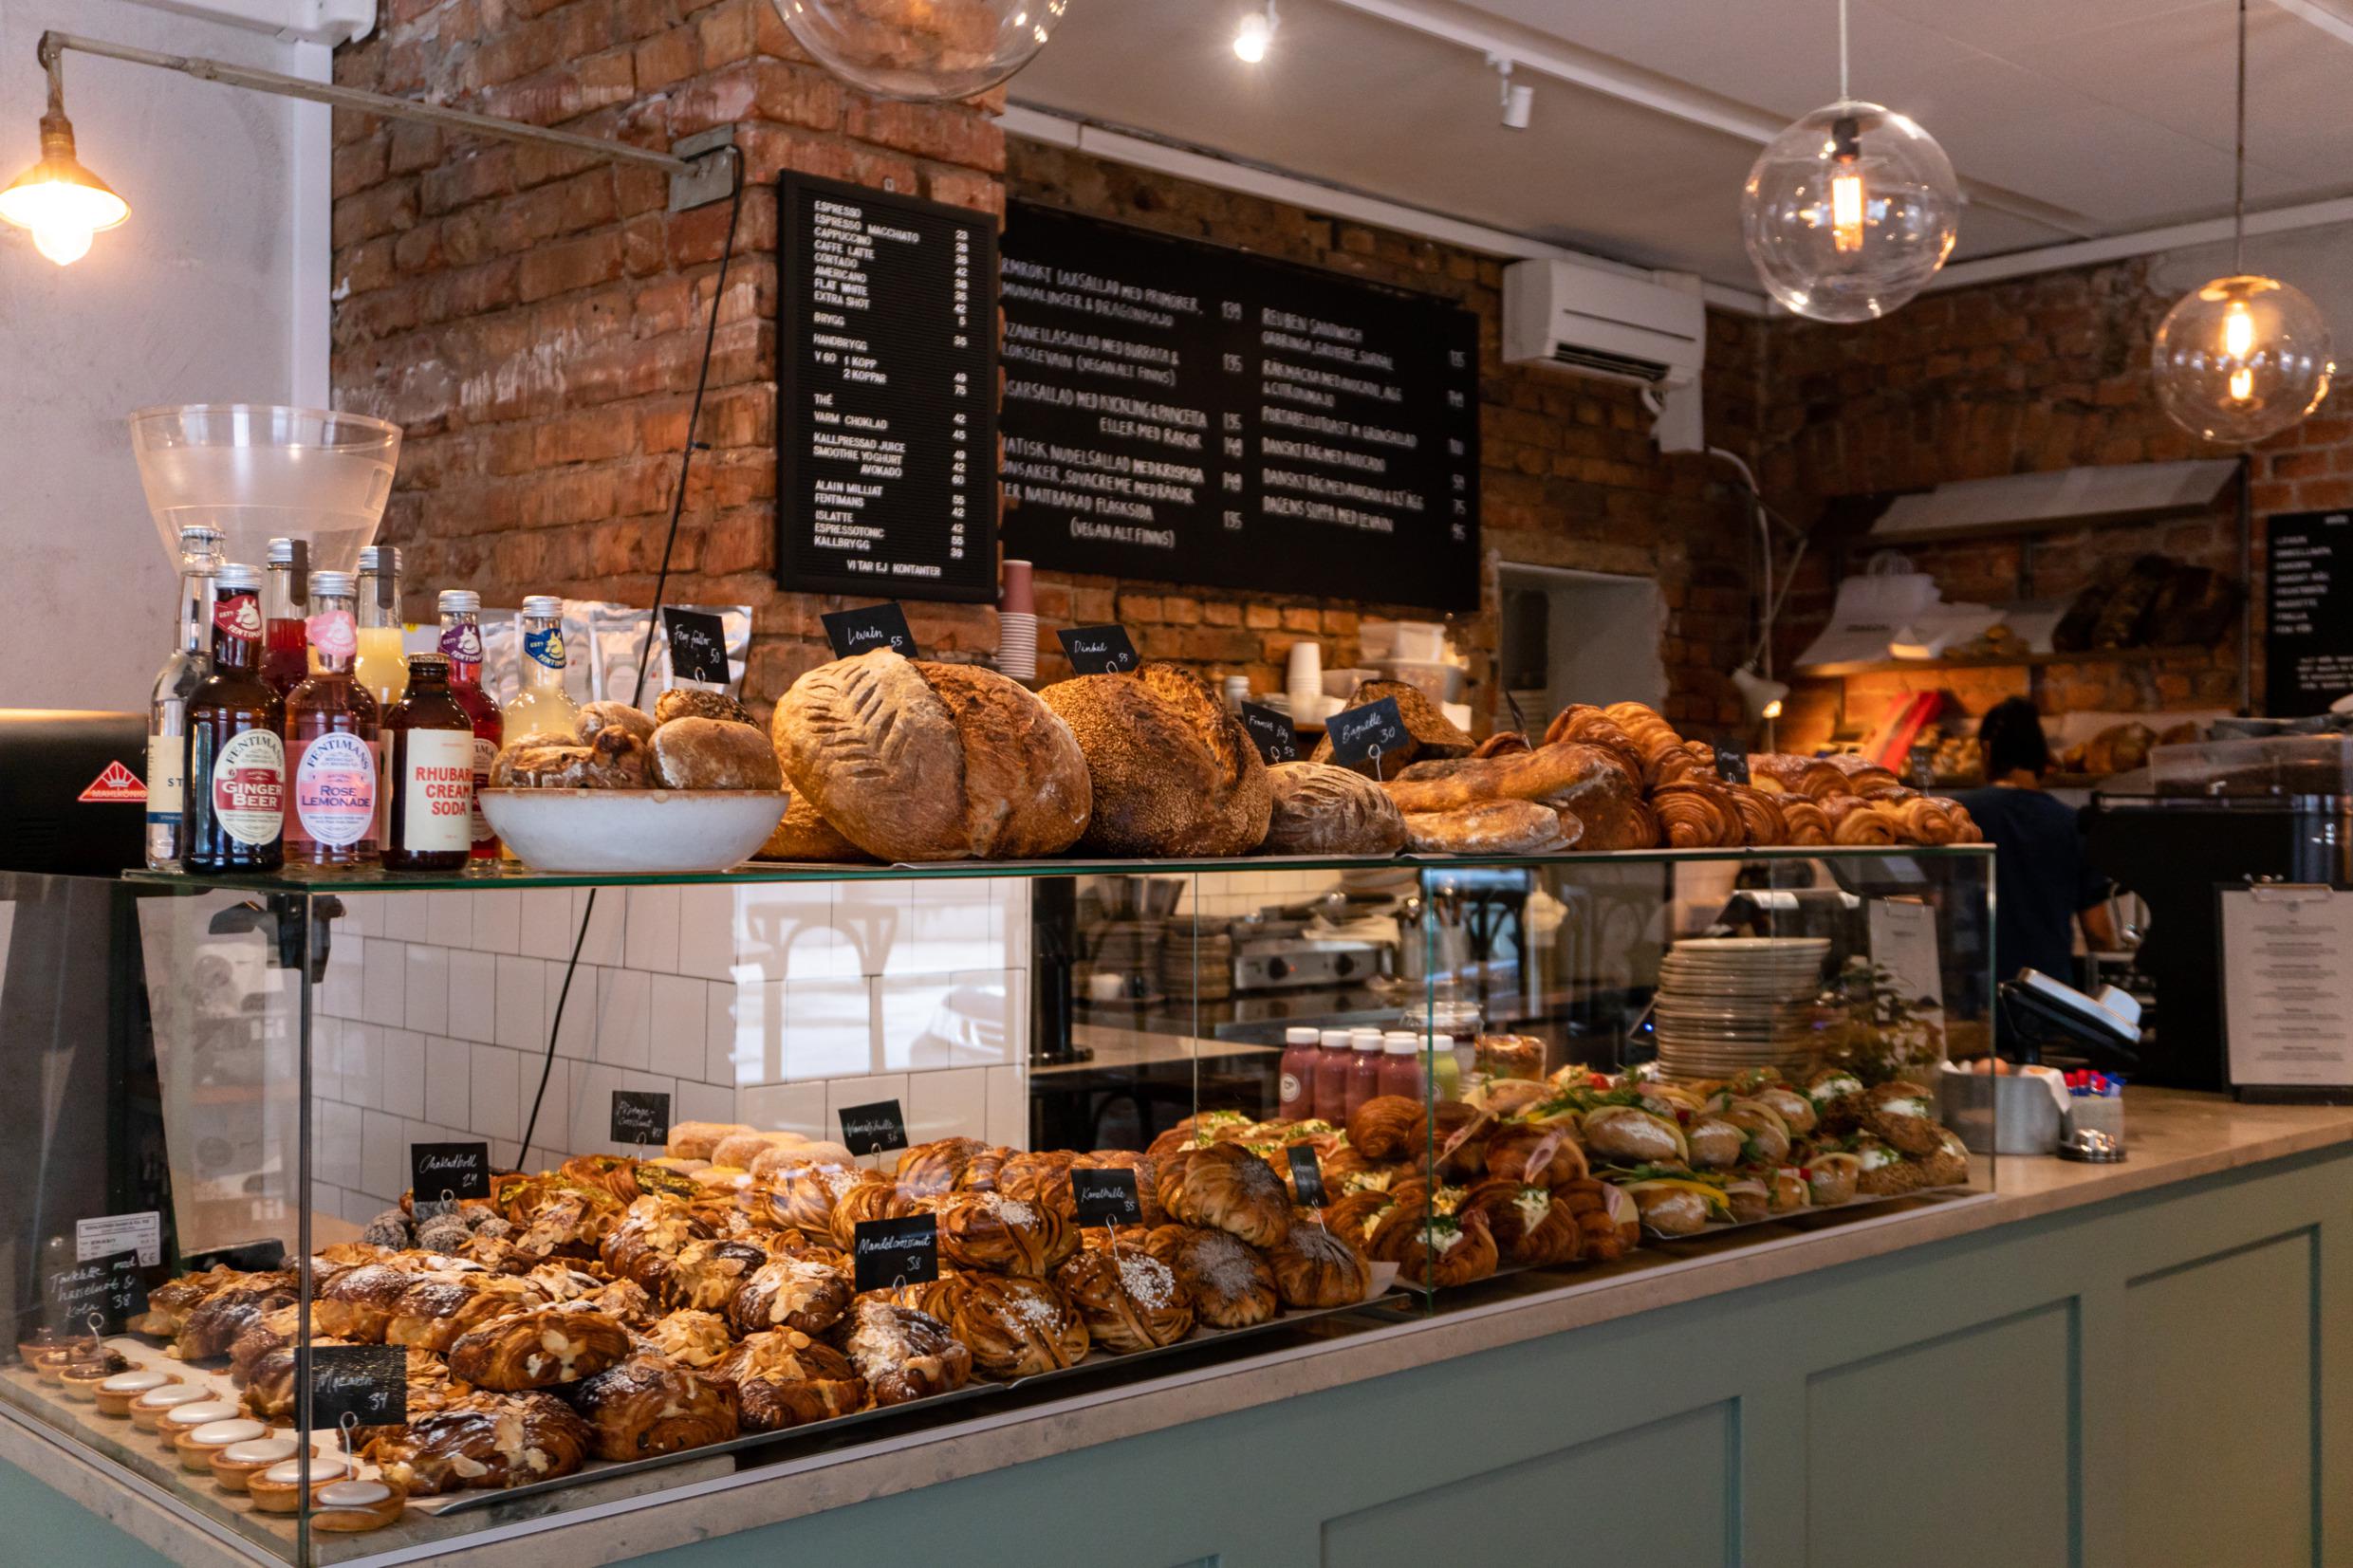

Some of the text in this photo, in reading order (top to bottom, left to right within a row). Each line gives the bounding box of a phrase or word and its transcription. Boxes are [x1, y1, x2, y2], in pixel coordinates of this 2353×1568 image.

[814, 200, 862, 218] ESPRESSO
[814, 213, 862, 231] ESPRESSO
[867, 224, 920, 243] MACCHIATO
[814, 226, 873, 246] CAPPUCCINO
[814, 239, 968, 277] CAFFE LATTE 42
[814, 252, 859, 268] CORTADO
[814, 266, 867, 283] AMERICANO
[814, 278, 967, 313] FLAT WHITE 42
[814, 290, 843, 304] EXTRA
[845, 296, 871, 309] SHOT
[1121, 286, 1142, 301] MED
[814, 312, 845, 326] BRYGG
[813, 333, 868, 351] HANDBRYGG
[851, 356, 878, 368] KOPP
[843, 368, 851, 378] 2
[852, 369, 887, 383] KOPPAR
[813, 393, 967, 424] THÉ 42
[1076, 391, 1098, 408] MED
[813, 411, 967, 440] VARM CHOKLAD 45
[1100, 416, 1137, 435] ELLER
[1138, 423, 1161, 440] MED
[813, 432, 967, 461] KALLPRESSAD JUICE 49
[813, 445, 966, 472] SMOOTHIE YOGHURT 42
[1049, 444, 1130, 472] NUDELSALLAD
[1132, 458, 1155, 475] MED
[860, 464, 965, 486] AVOKADO 60
[815, 479, 965, 506] ALAIN MILLIAT 55
[1025, 486, 1093, 510] NATTBAKAD
[1134, 481, 1157, 497] MED
[815, 492, 965, 518] FENTIMANS 42
[815, 509, 964, 534] ISLATTE 42
[814, 523, 964, 546] ESPRESSOTONIC 55
[814, 535, 963, 559] KALLBRYGG 39
[846, 559, 941, 576] VI TAR EJ KONTANTER
[847, 625, 883, 646] Levain
[890, 636, 903, 648] 55
[1074, 639, 1107, 654] Dinkel
[1119, 652, 1128, 662] 55
[1342, 711, 1382, 745] Baguette
[1380, 726, 1396, 744] 30
[306, 739, 369, 770] FENTIMANS
[1284, 746, 1296, 757] 55
[167, 777, 184, 787] ST
[221, 781, 283, 795] GINGER
[320, 785, 357, 797] ROSE
[232, 792, 277, 807] BEER
[425, 784, 471, 799] CREAM
[301, 795, 371, 807] LEMONADE
[431, 801, 467, 816] SODA
[111, 1293, 132, 1309] 38
